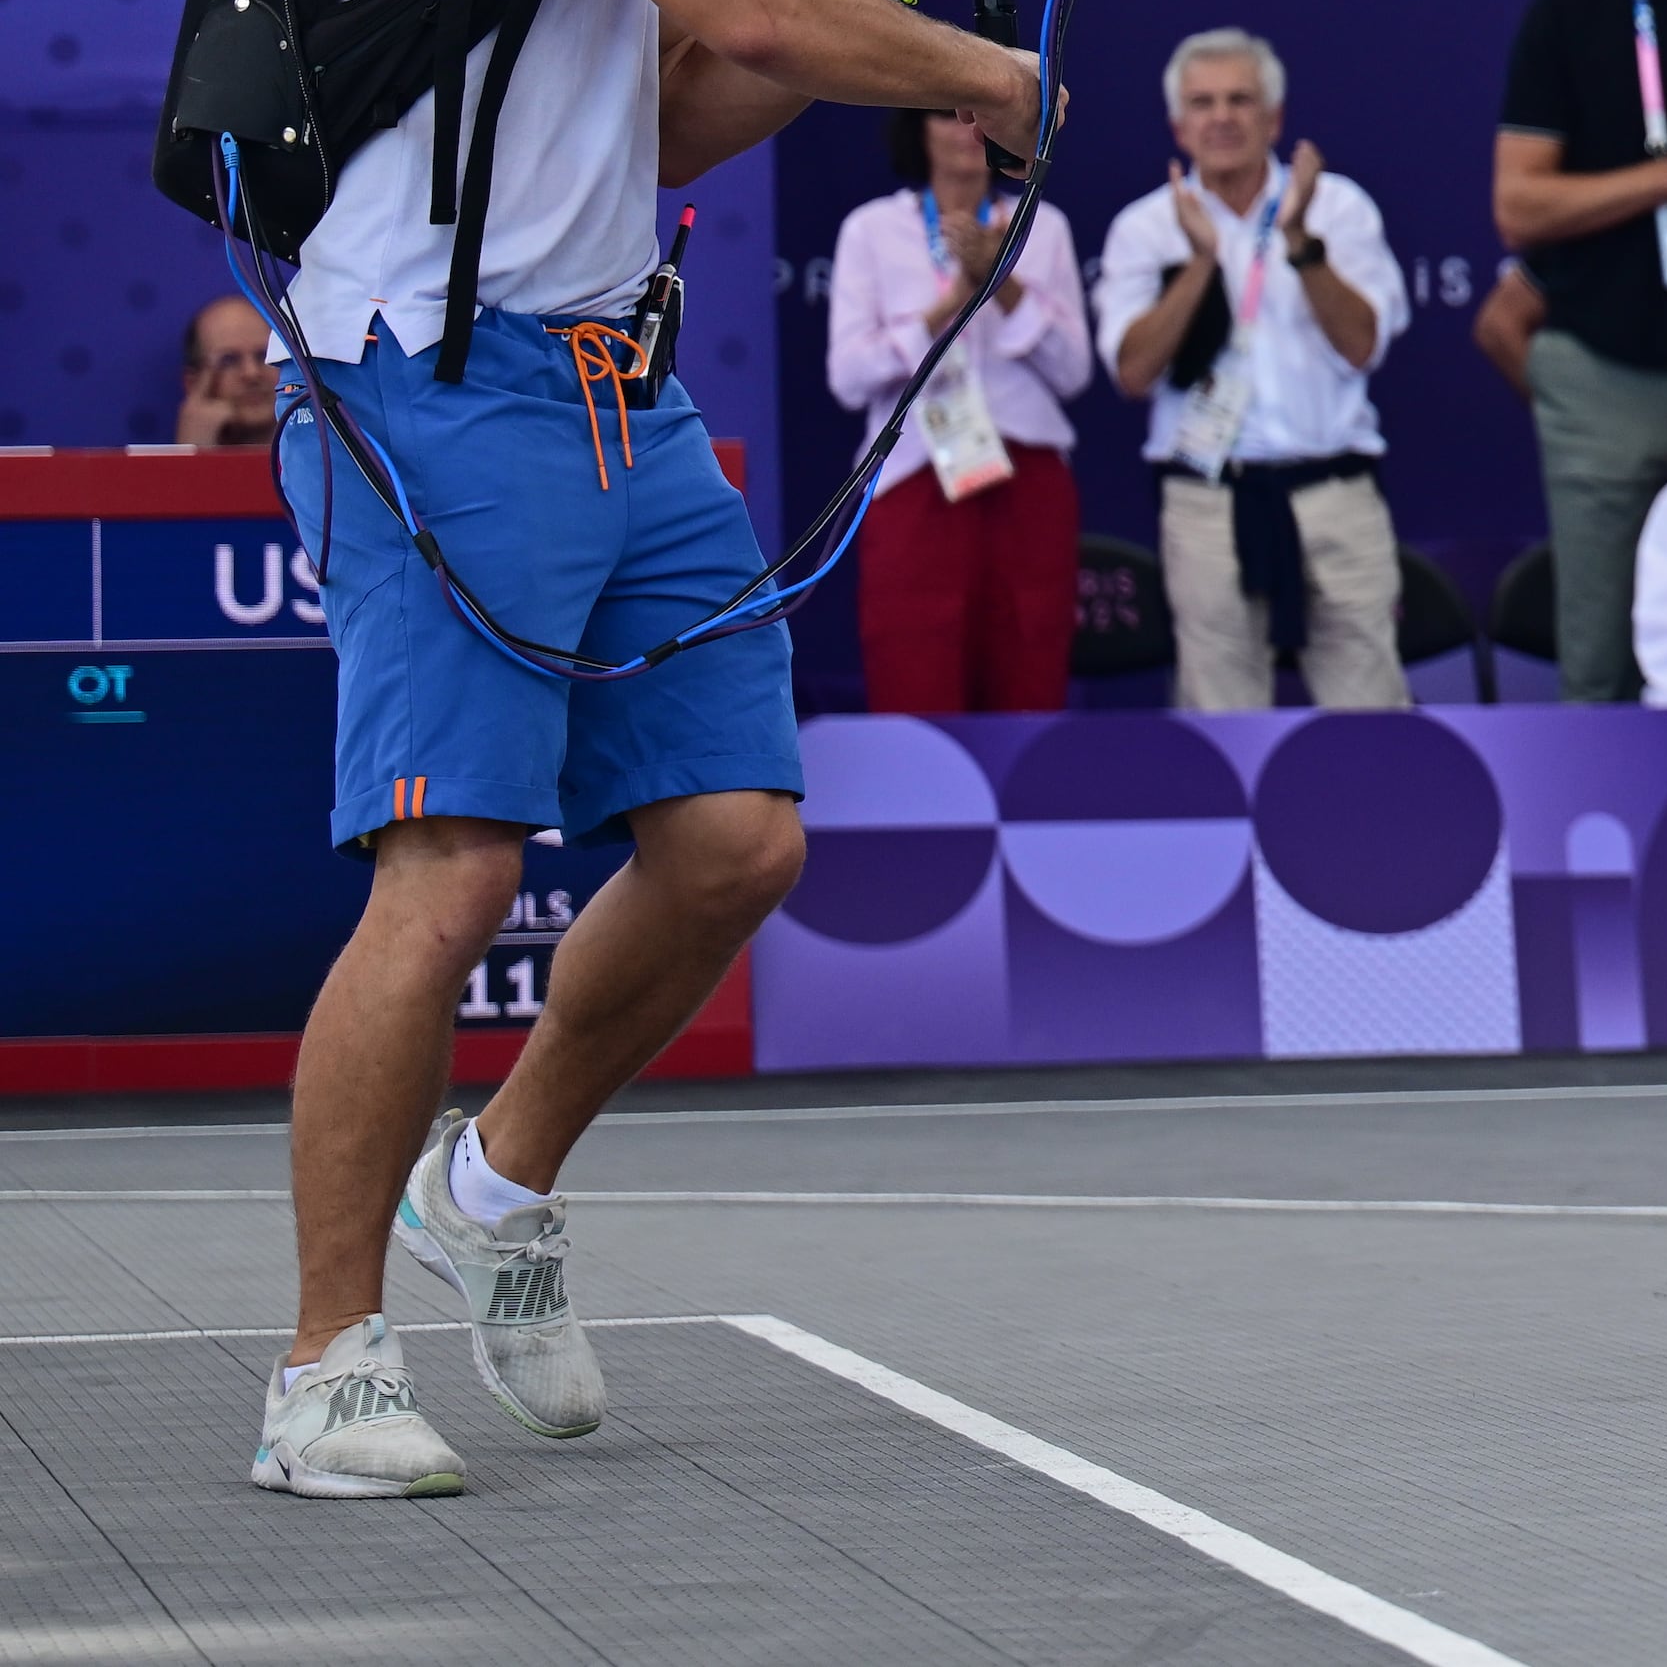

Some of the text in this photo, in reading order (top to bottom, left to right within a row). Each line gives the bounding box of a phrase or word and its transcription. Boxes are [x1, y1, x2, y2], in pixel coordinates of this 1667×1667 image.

[213, 542, 327, 625] US
[67, 664, 134, 704] OT
[457, 954, 546, 1018] 11
